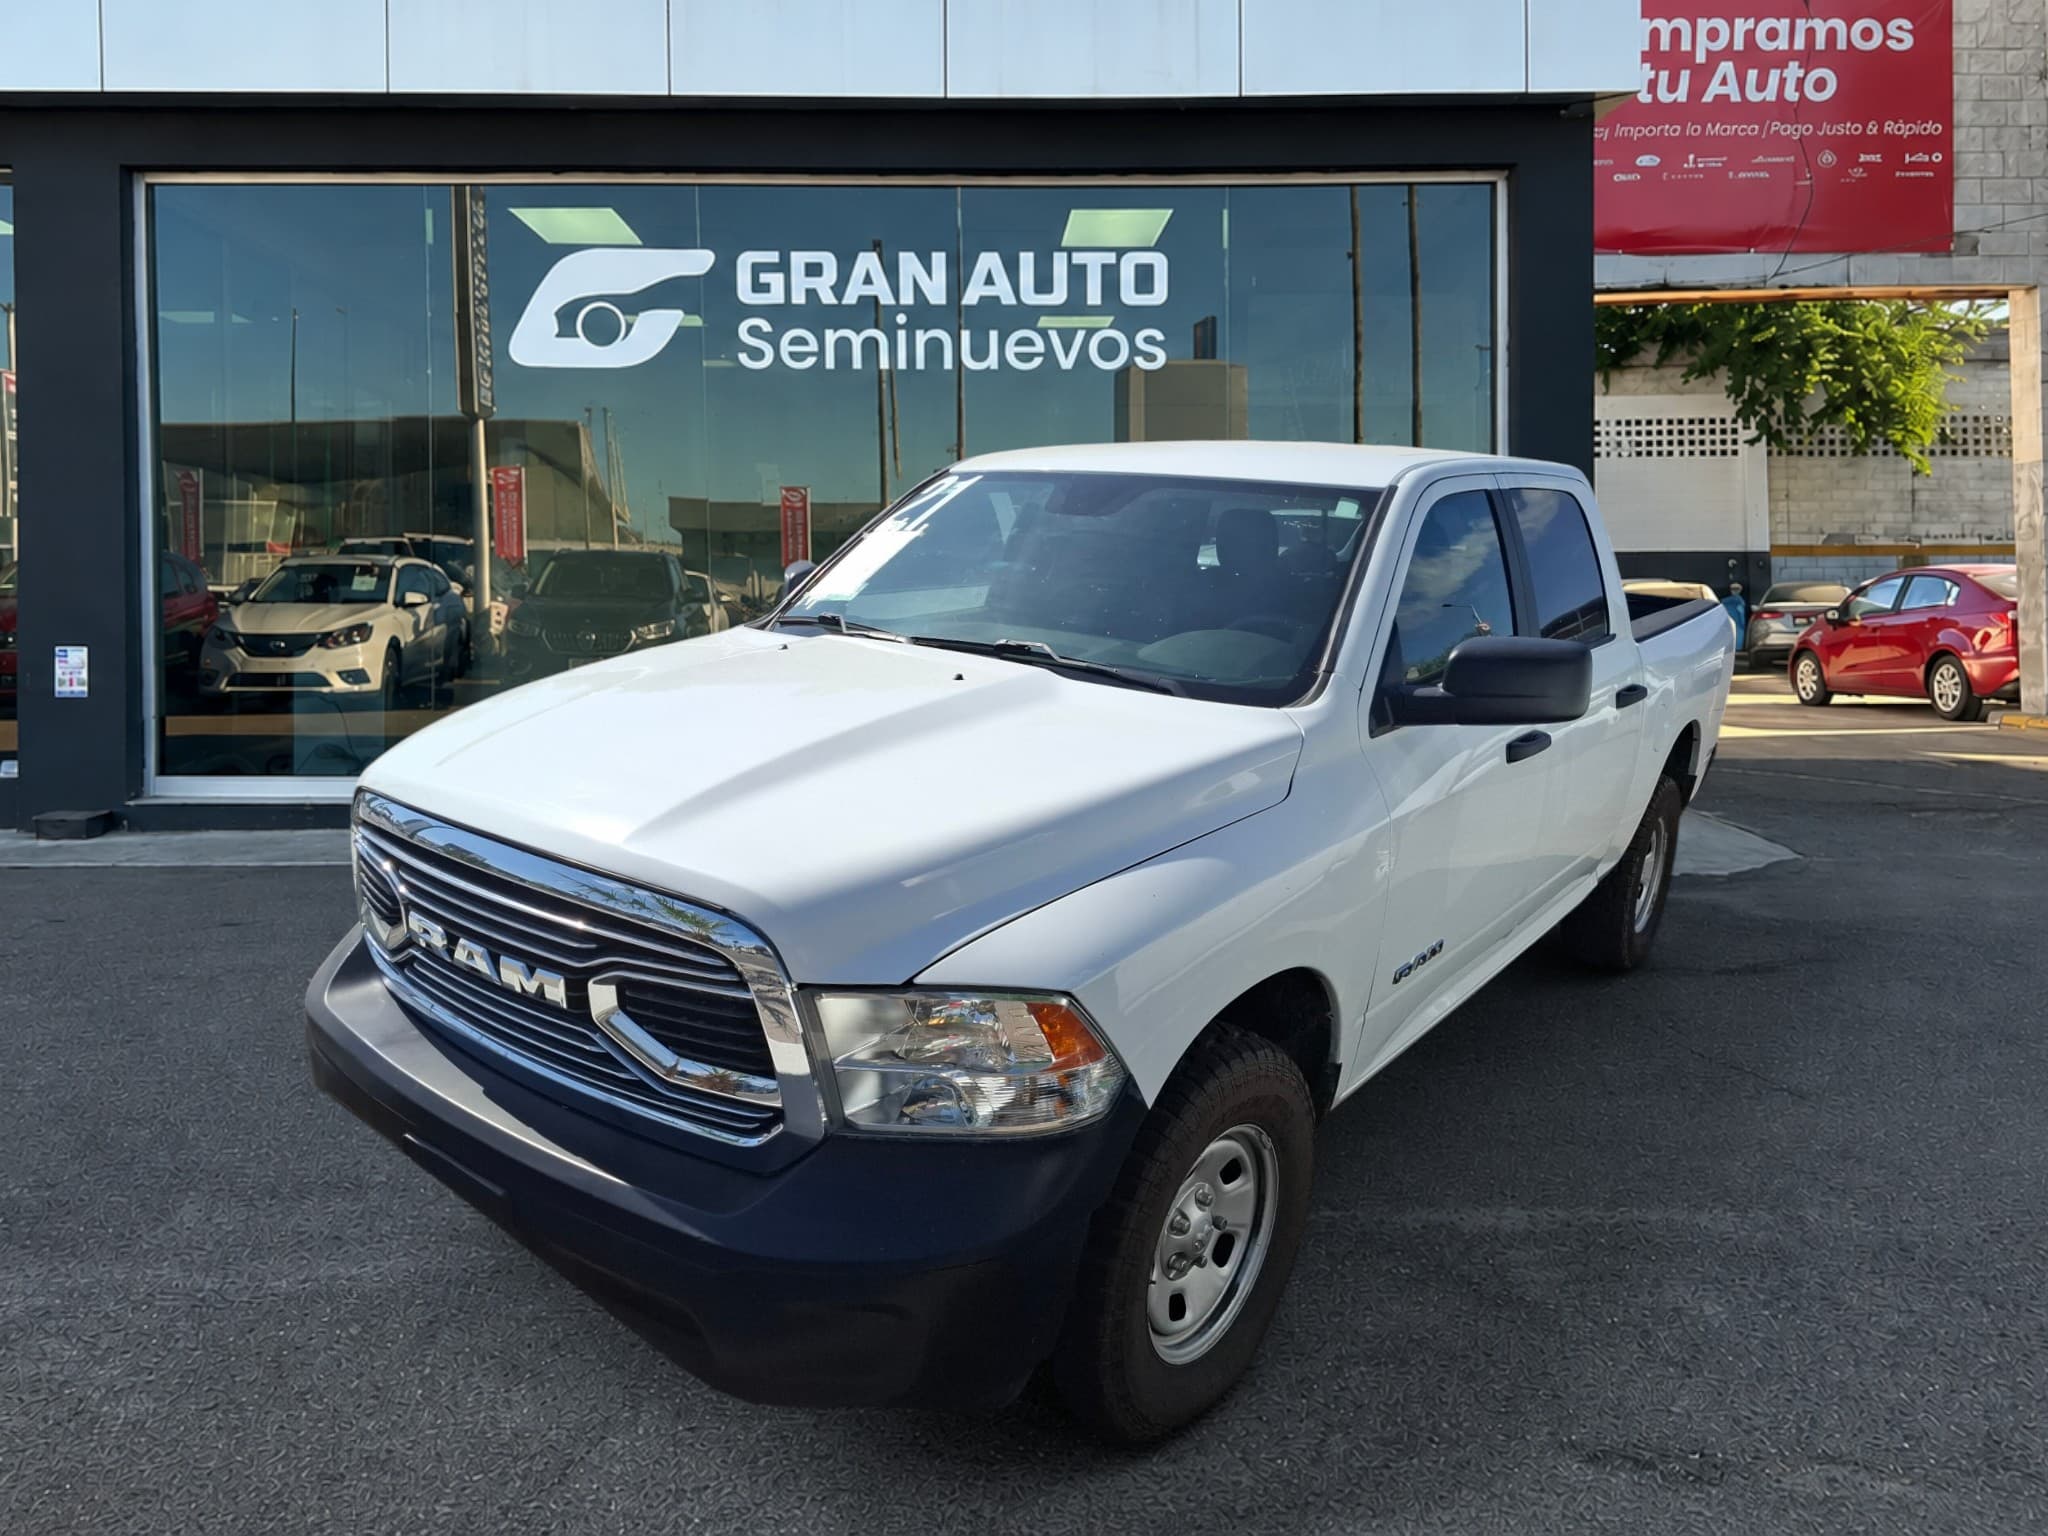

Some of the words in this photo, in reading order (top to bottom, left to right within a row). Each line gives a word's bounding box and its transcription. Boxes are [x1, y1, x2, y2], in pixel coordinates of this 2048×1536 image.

[1637, 63, 1690, 103] tu
[1701, 61, 1838, 103] Auto
[1614, 123, 1681, 141] Importa
[1817, 121, 1863, 136] Justo
[1866, 120, 1879, 135] &
[736, 250, 948, 306] GRAN
[960, 250, 1169, 307] AUTO
[737, 312, 1168, 371] Seminuevos
[408, 910, 568, 1010] RAM
